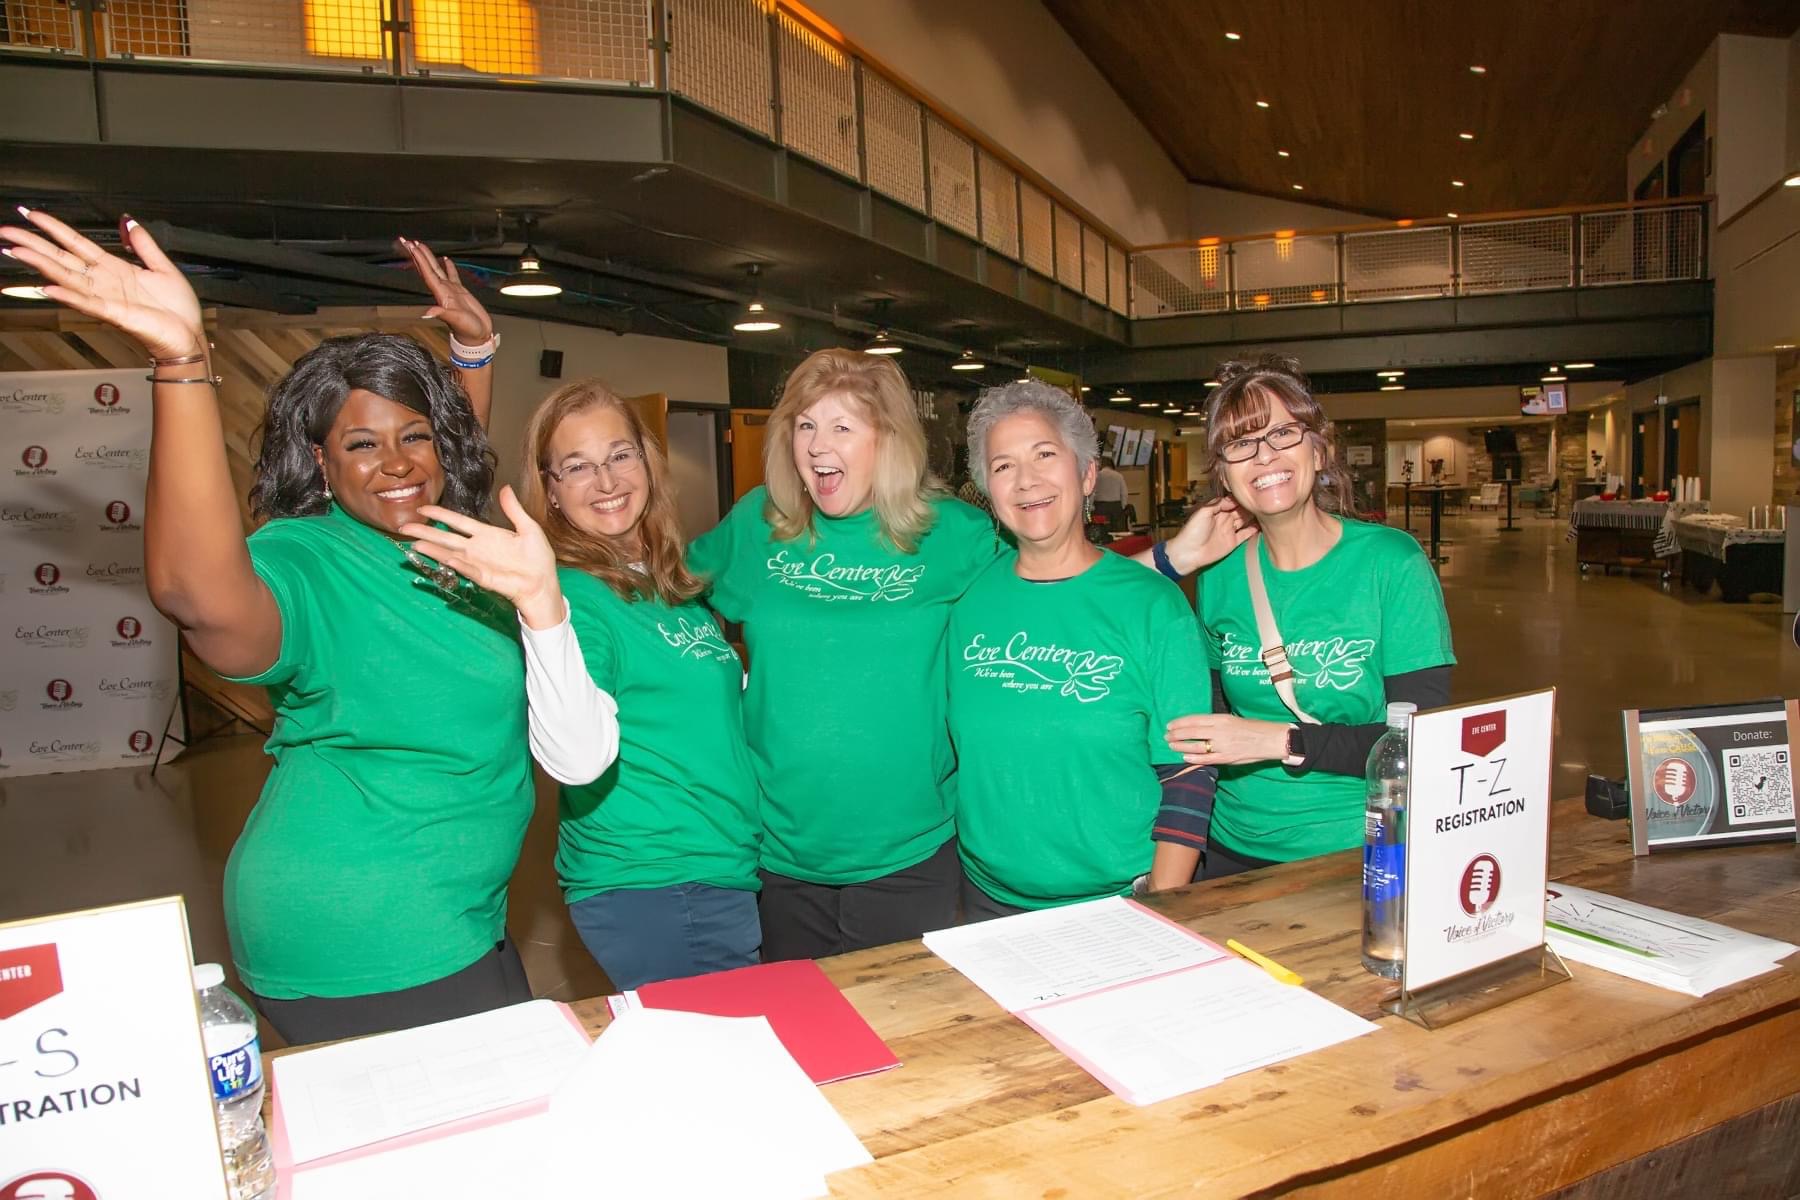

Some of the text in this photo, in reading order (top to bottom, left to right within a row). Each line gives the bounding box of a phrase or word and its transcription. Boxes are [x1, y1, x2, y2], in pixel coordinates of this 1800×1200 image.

[13, 388, 48, 402] Center
[96, 445, 130, 459] Center
[23, 507, 59, 521] Center
[107, 562, 141, 577] Center
[767, 550, 884, 581] Eve Center
[36, 625, 72, 638] Center
[963, 631, 1077, 664] Eve Center
[1222, 633, 1253, 659] Eve
[119, 677, 153, 690] Center
[50, 739, 85, 753] Center
[1733, 731, 1773, 742] Donate:
[1451, 758, 1511, 804] T-Z
[1436, 798, 1525, 833] REGISTRATION
[1443, 925, 1472, 942] Voice
[1482, 911, 1515, 931] Victory
[212, 1050, 246, 1072] Pure
[217, 1062, 245, 1082] Life
[0, 1078, 142, 1125] TRATION
